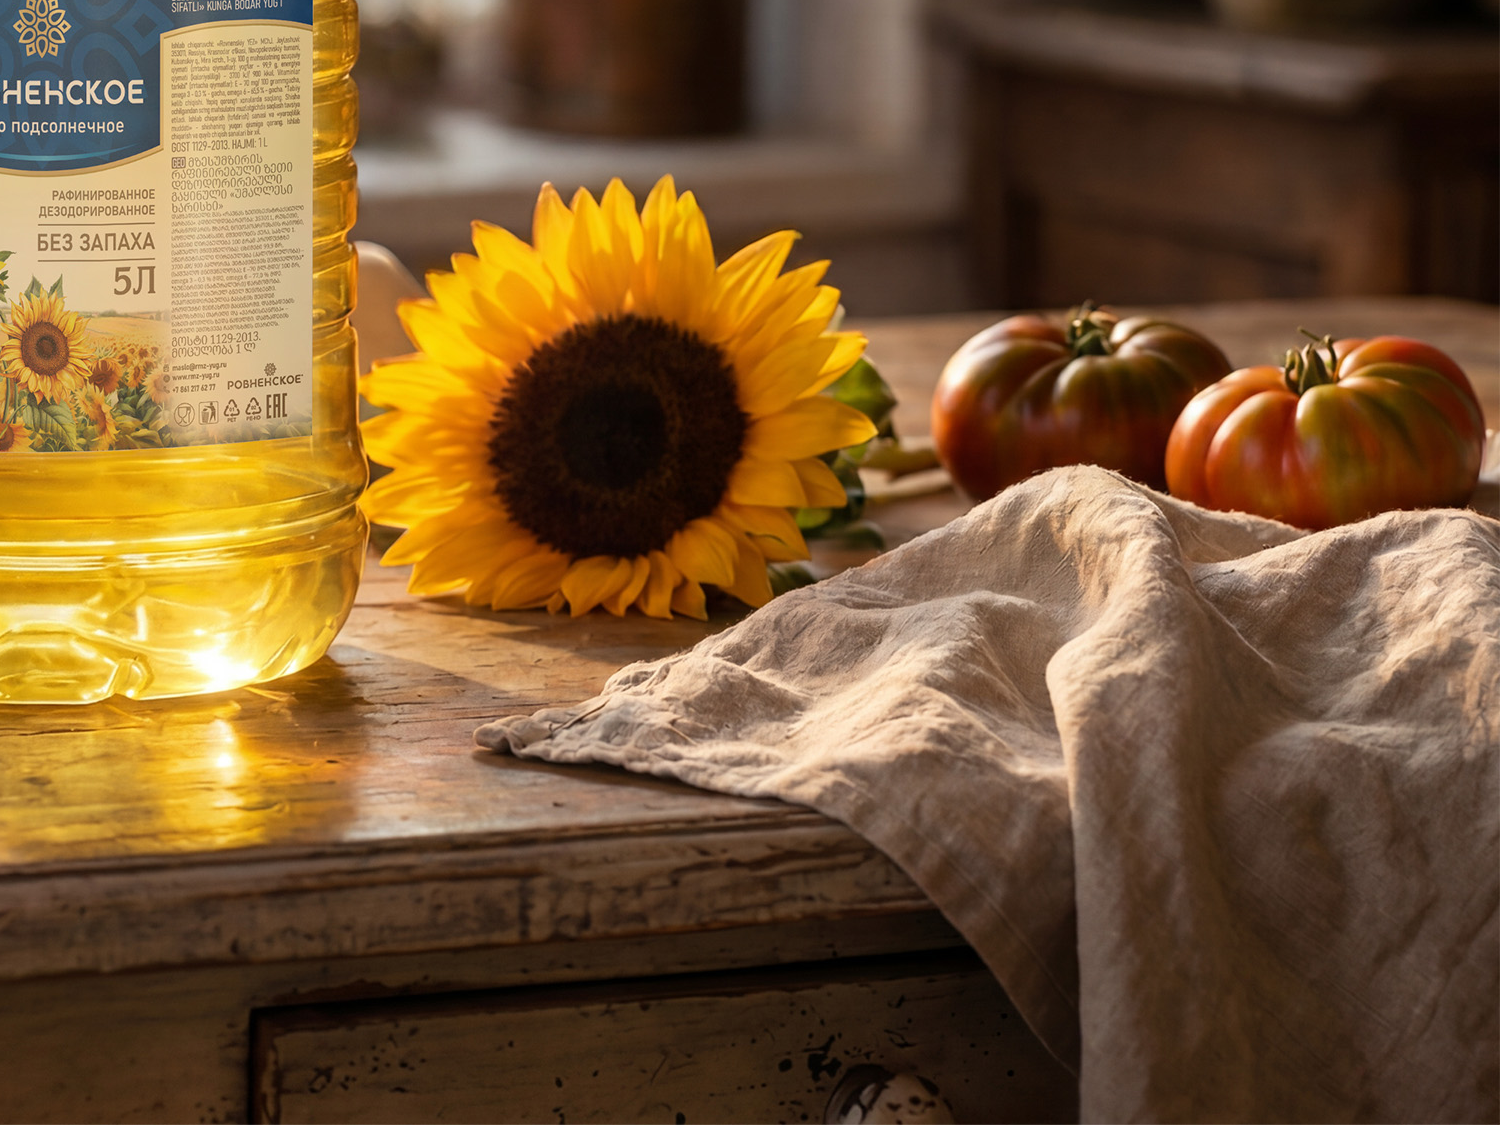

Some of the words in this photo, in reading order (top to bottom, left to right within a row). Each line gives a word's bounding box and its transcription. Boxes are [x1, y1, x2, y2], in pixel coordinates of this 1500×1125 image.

[172, 1, 204, 13] SIFATLI»
[207, 0, 232, 11] KUNGA
[12, 121, 124, 135] подсолнечное
[172, 142, 190, 153] GOST
[232, 139, 256, 149] HAJMI:
[264, 137, 268, 147] L
[172, 158, 185, 168] GEO
[52, 189, 155, 201] РАФИНИРОВАННОЕ
[39, 205, 155, 218] ДЕЗОДОРИРОВАННОЕ
[38, 233, 73, 251] БЕЗ
[80, 232, 155, 251] ЗАПАХА
[114, 266, 156, 295] 5Л
[211, 331, 261, 344] 1129-2013.
[236, 344, 240, 353] 1
[172, 372, 220, 381] www.rmz-yug.ru
[228, 375, 301, 390] РОВНЕНСКОЕ
